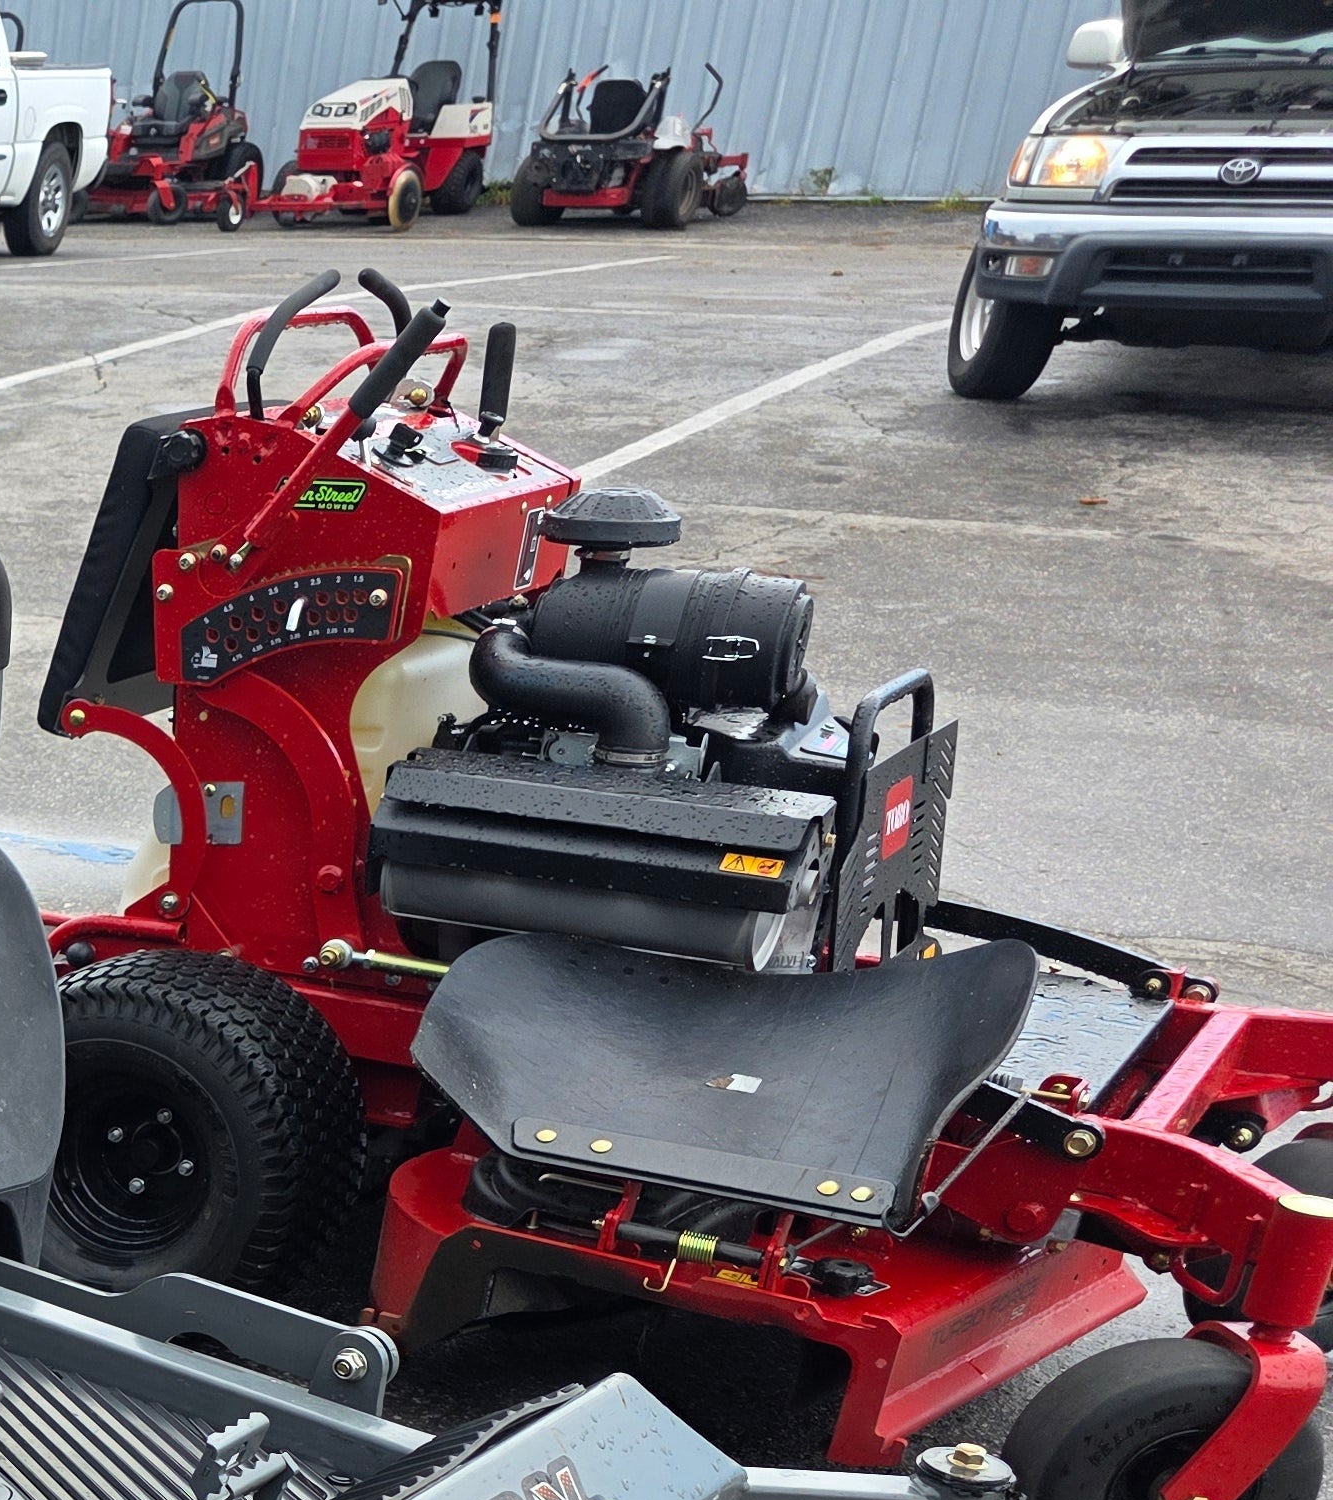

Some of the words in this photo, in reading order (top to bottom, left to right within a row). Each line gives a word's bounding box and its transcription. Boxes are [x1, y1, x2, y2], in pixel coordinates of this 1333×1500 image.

[315, 485, 360, 503] Street
[353, 575, 365, 583] 1.5
[886, 799, 911, 836] TORO
